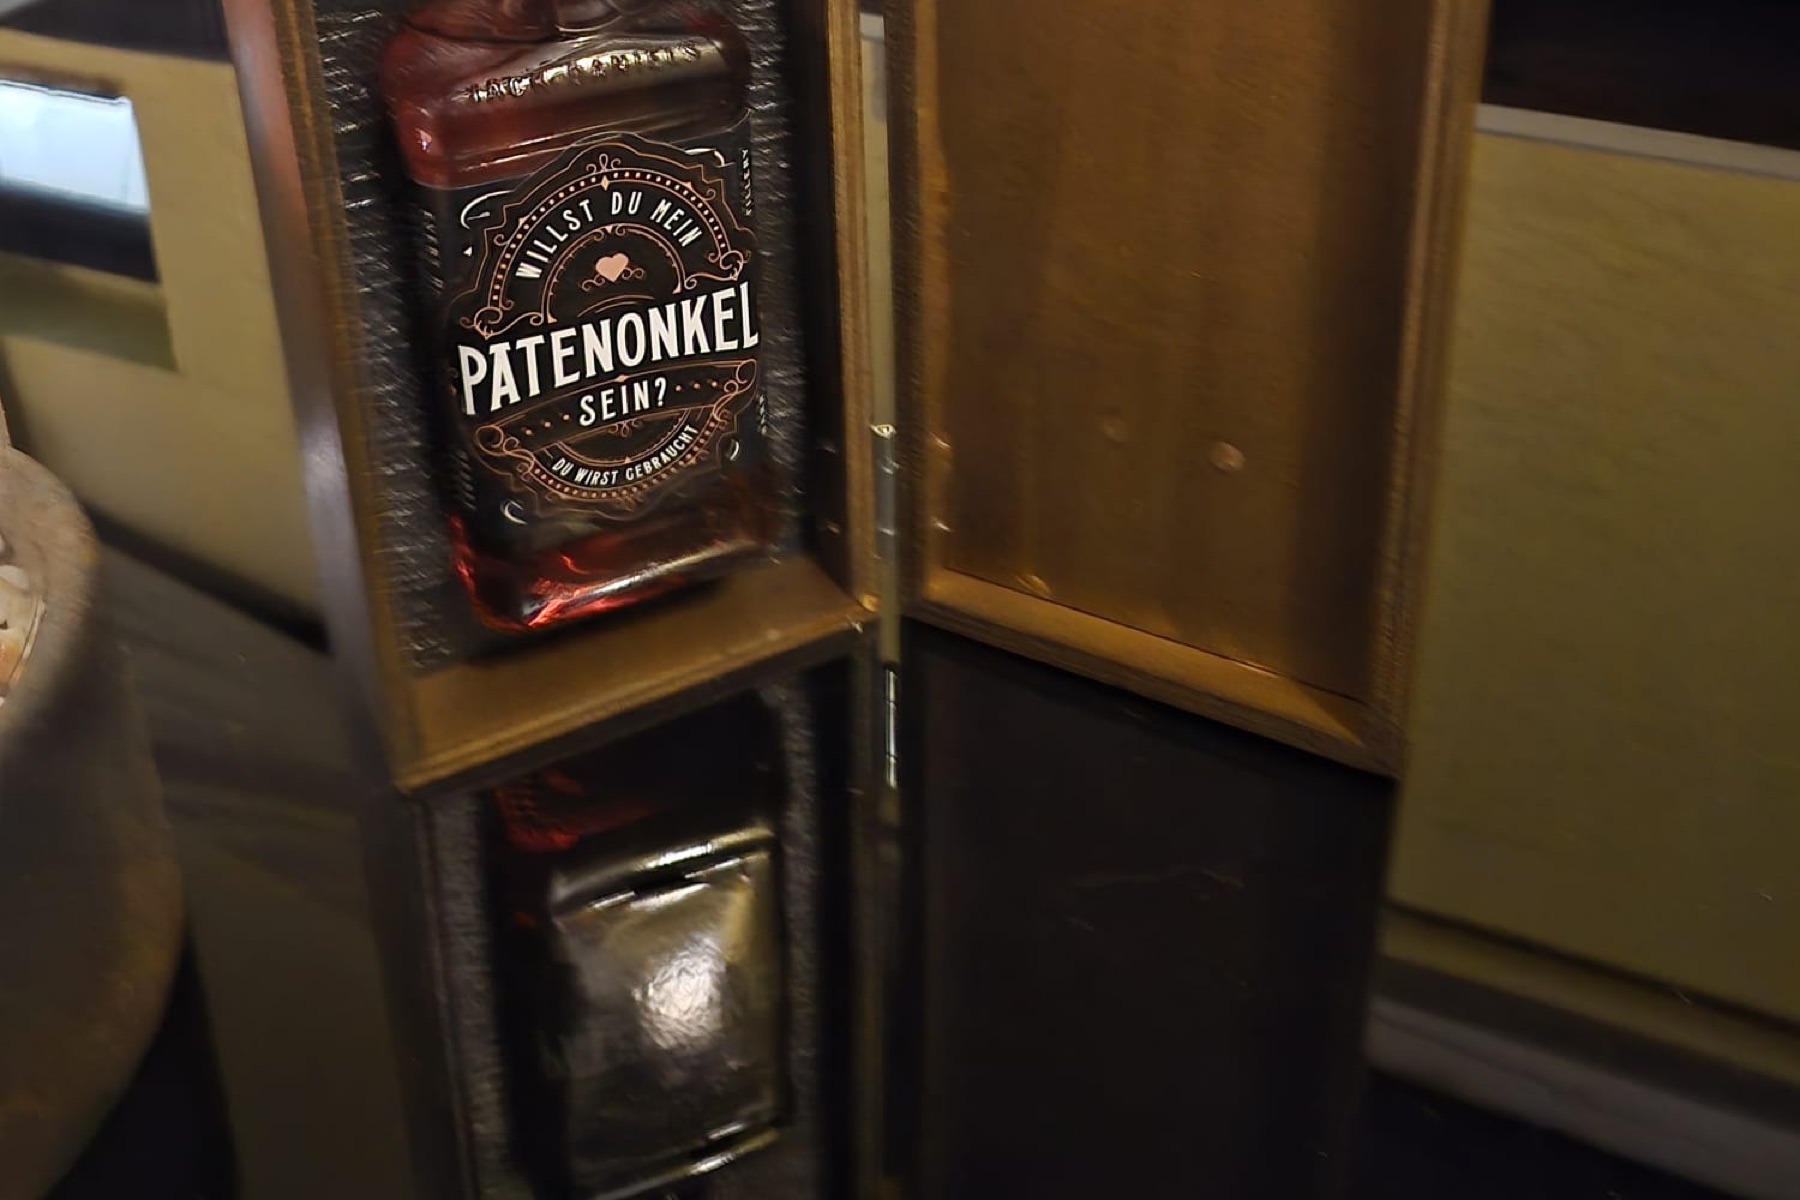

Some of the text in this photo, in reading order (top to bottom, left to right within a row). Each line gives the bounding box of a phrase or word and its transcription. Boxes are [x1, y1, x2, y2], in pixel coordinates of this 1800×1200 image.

[514, 191, 704, 280] WILLST DU MEIN
[458, 281, 759, 416] PATENONKEL
[578, 377, 668, 427] SEIN?
[551, 424, 699, 486] DU WIRST GEBRAUCHT
